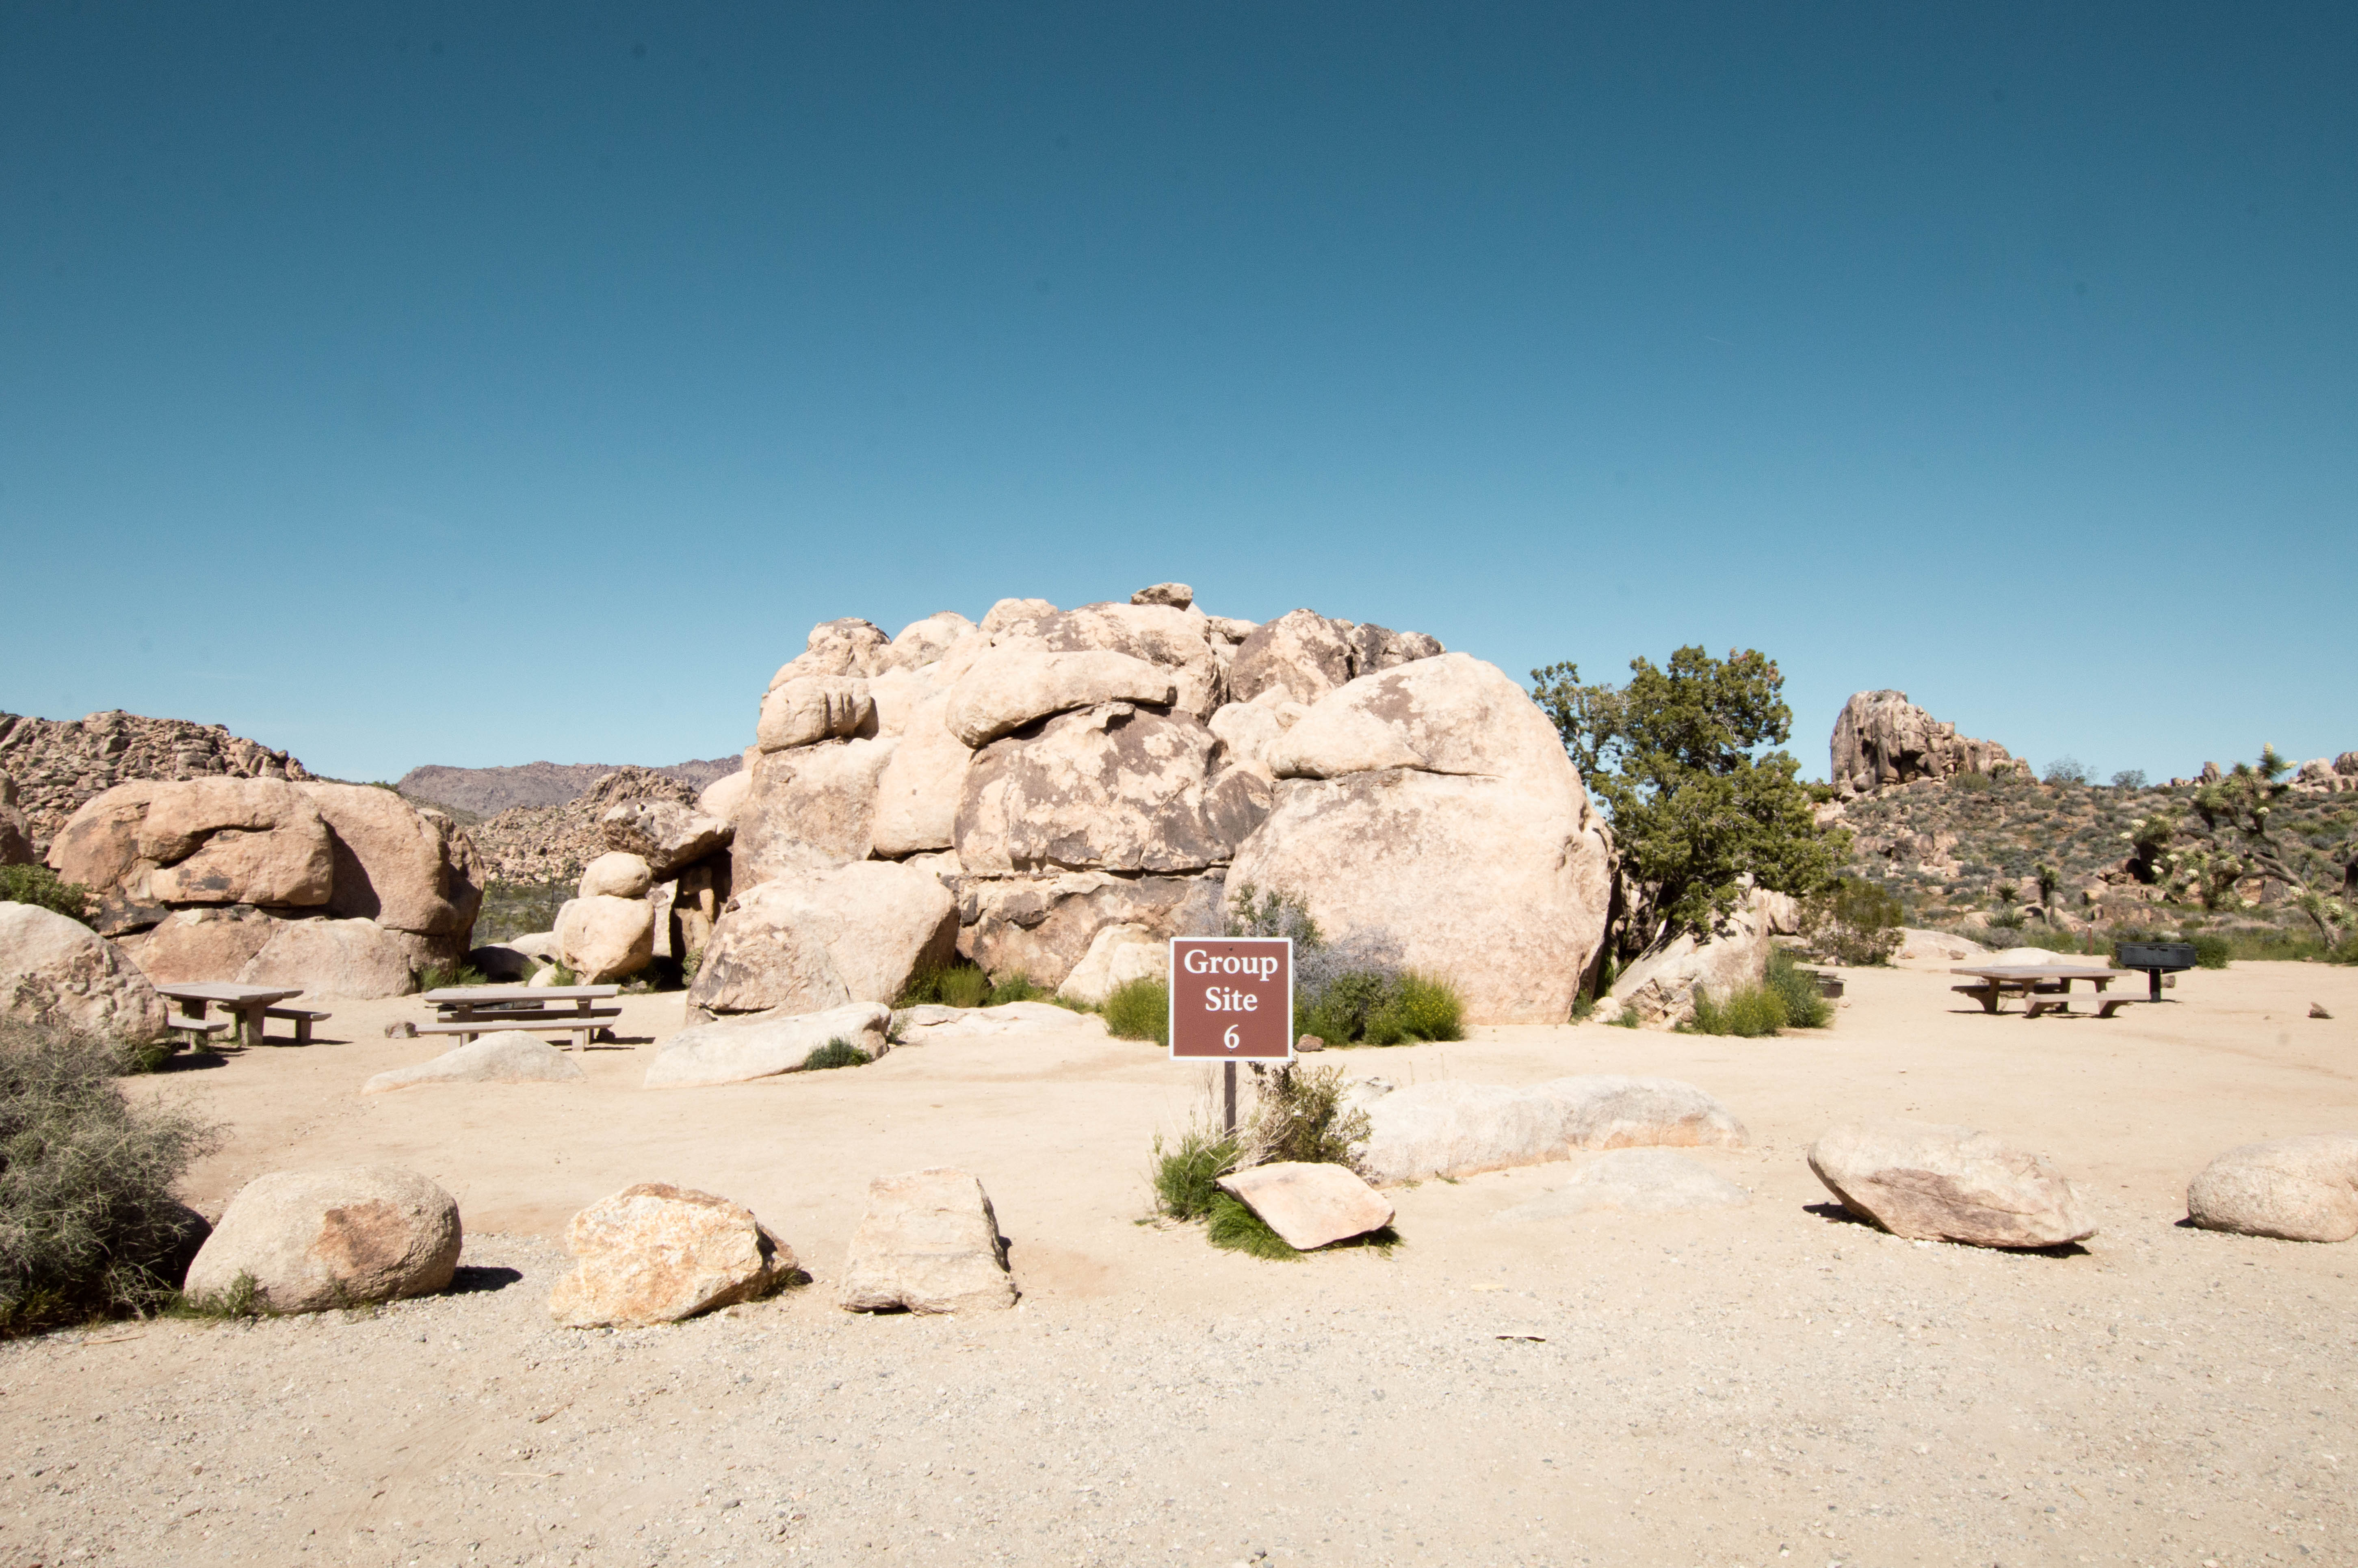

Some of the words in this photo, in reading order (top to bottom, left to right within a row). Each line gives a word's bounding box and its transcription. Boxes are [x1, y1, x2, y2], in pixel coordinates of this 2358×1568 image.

[1184, 949, 1278, 981] Group
[1205, 987, 1258, 1011] Site
[1224, 1024, 1240, 1049] 6
